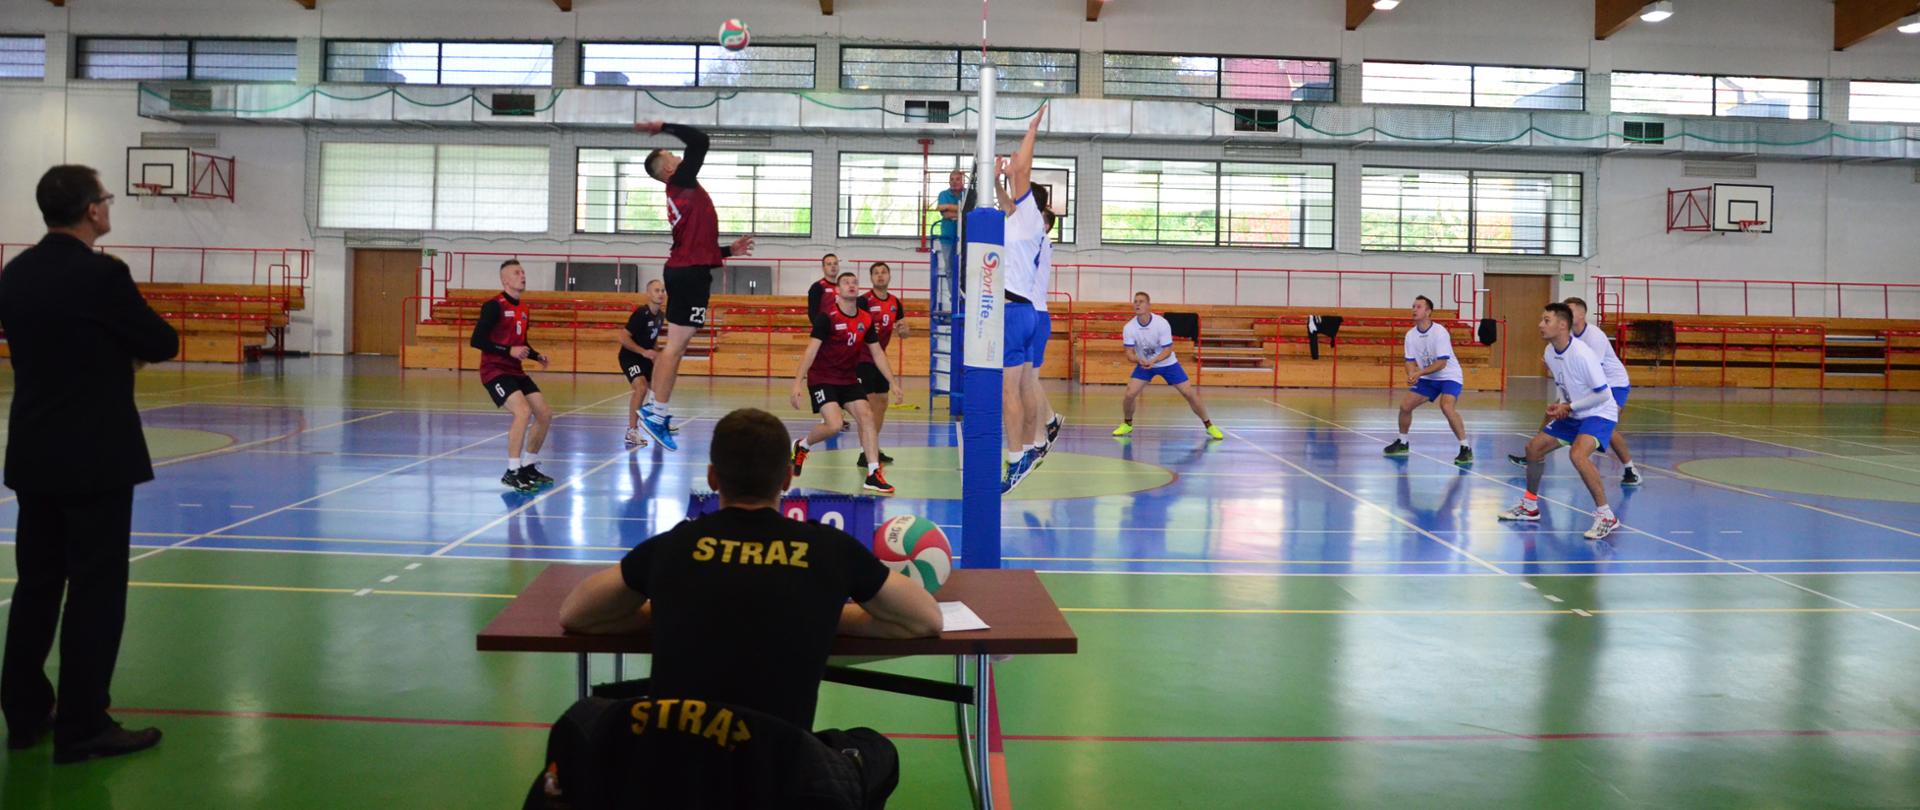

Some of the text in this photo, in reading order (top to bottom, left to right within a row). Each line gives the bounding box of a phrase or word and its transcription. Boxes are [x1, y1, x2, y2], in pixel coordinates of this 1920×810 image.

[689, 306, 706, 323] 23
[882, 314, 890, 326] 9
[516, 320, 522, 335] 6
[847, 331, 857, 346] 21
[628, 365, 641, 377] 20
[495, 383, 506, 398] 6
[815, 389, 826, 404] 21
